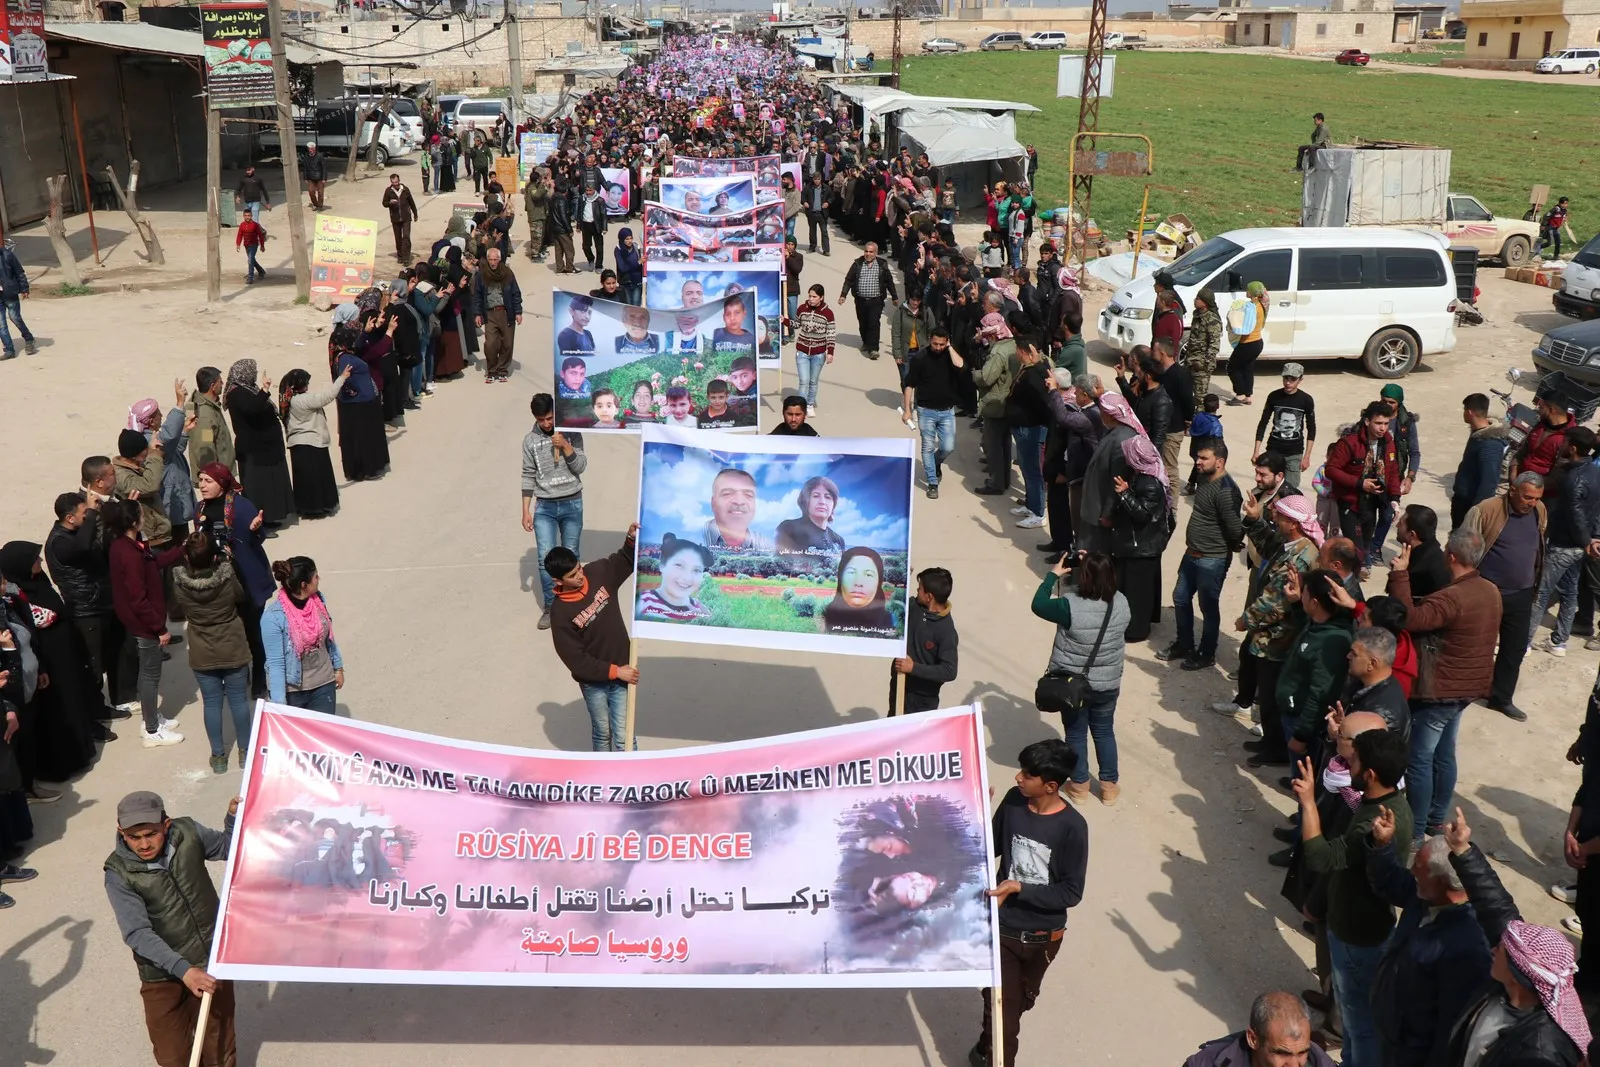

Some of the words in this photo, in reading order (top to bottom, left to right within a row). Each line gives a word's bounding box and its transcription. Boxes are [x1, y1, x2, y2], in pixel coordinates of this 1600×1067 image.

[203, 11, 237, 24] وصرافة
[238, 11, 266, 23] حوالات
[248, 23, 262, 39] أبو
[212, 26, 247, 39] مظلوم
[367, 759, 416, 788] AXA
[422, 768, 457, 792] ME
[547, 780, 602, 803] DİKE
[607, 780, 691, 803] ZAROK
[701, 775, 718, 797] Û
[724, 766, 830, 793] MEZİNEN
[837, 759, 872, 786] ME
[878, 751, 962, 784] DİKUJE
[456, 828, 564, 859] RÛSİYA
[569, 831, 595, 860] JÎ
[602, 830, 640, 860] BÊ
[647, 832, 751, 860] DENGE
[1013, 838, 1037, 852] SAILING
[369, 880, 447, 916] وكبارنا
[456, 884, 538, 912] أطفالنا
[546, 886, 598, 918] تقتل
[606, 887, 672, 918] أرضنا
[681, 887, 734, 918] تحتل
[521, 928, 599, 957] صامتة
[607, 931, 688, 962] وروسيا
